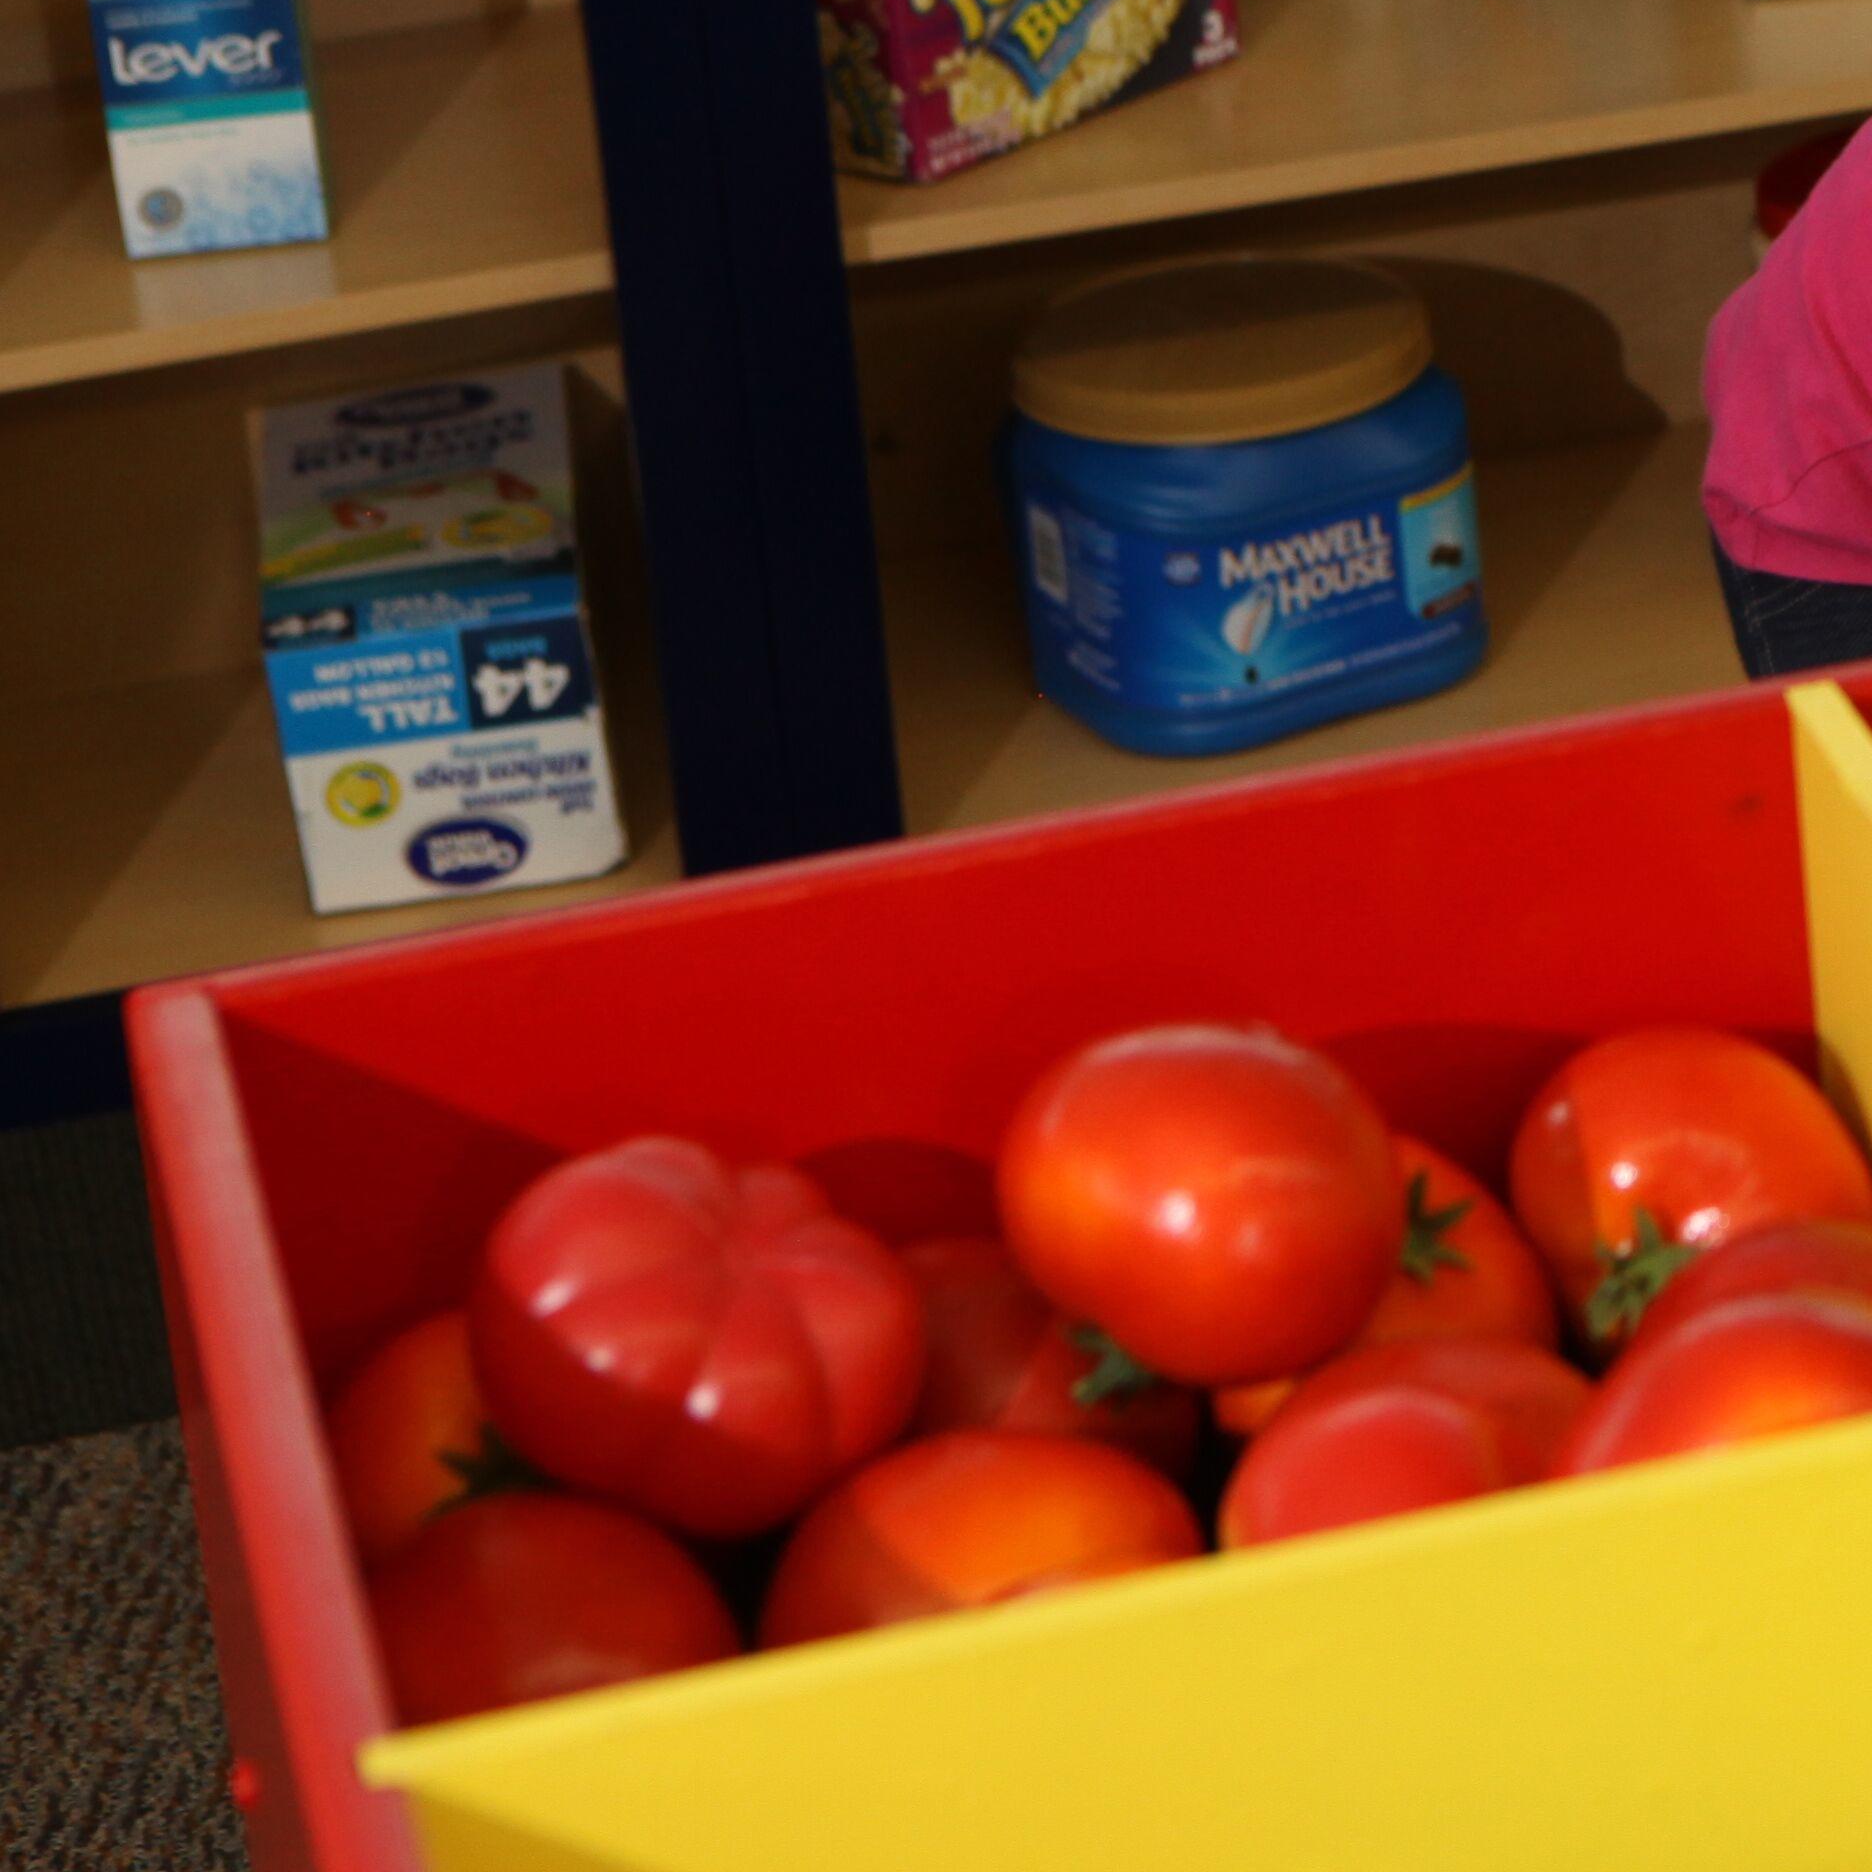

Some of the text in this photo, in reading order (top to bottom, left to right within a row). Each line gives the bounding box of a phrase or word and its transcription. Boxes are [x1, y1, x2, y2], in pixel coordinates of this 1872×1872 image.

[1218, 513, 1392, 589] MAXWELL
[1276, 546, 1396, 617] HOUSE
[358, 695, 460, 733] TALL
[471, 656, 571, 718] 44
